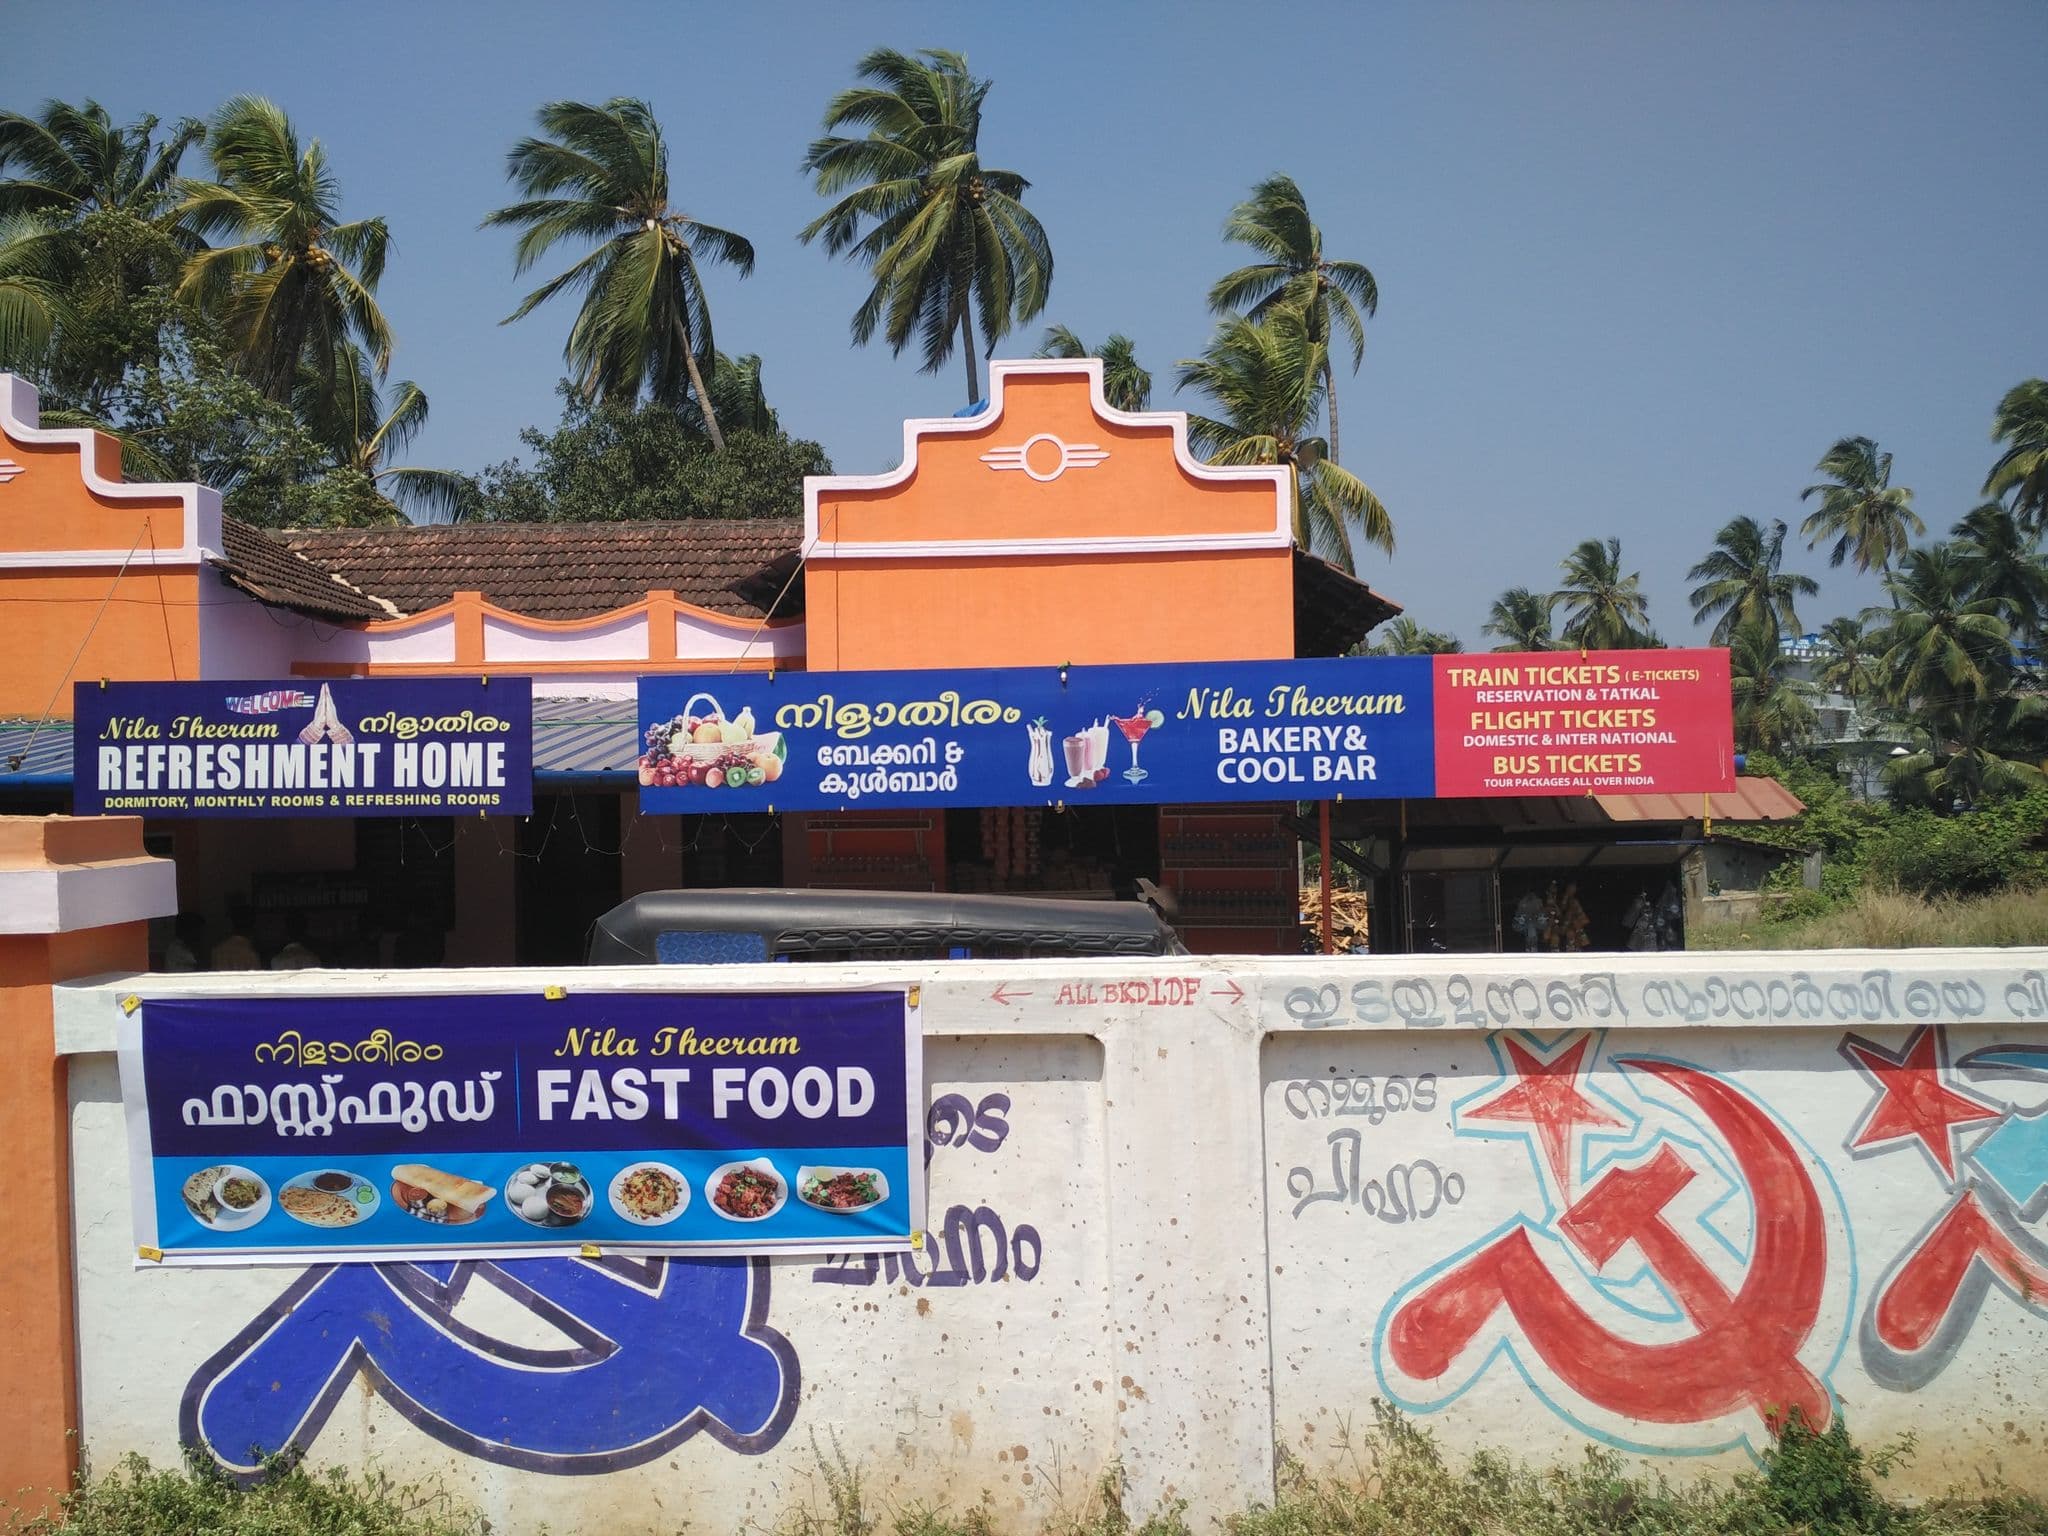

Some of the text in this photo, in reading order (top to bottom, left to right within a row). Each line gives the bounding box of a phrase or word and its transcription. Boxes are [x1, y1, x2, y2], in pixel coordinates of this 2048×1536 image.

[1447, 668, 1518, 687] TRAIN
[1525, 666, 1620, 686] TICKETS
[225, 690, 314, 715] WELCOME
[1176, 685, 1405, 720] Nila Theeram
[1476, 687, 1660, 703] RESERVATION & TATKAL
[99, 716, 280, 740] Nila Theeram
[359, 711, 510, 740] നിളാതീരം
[775, 691, 1021, 738] നിളാതീരം
[1471, 709, 1656, 730] FLIGHT TICKETS
[817, 737, 965, 766] ബേക്കറി &
[1463, 732, 1676, 748] DOMESTIC & INTER NATIONAL
[98, 742, 506, 791] REFRESHMENT HOME
[1217, 755, 1376, 784] COOL BAR
[1494, 754, 1642, 775] BUS TICKETS
[1484, 775, 1655, 788] TOUR PACKAGES ALL OVER INDIA
[104, 793, 501, 810] DORMITORY, MONTHLY ROOMS & REFRESHING ROOMS
[255, 1029, 444, 1068] നിളാതീരം
[554, 1027, 801, 1057] Nila Theeram
[537, 1066, 875, 1121] FAST FOOD
